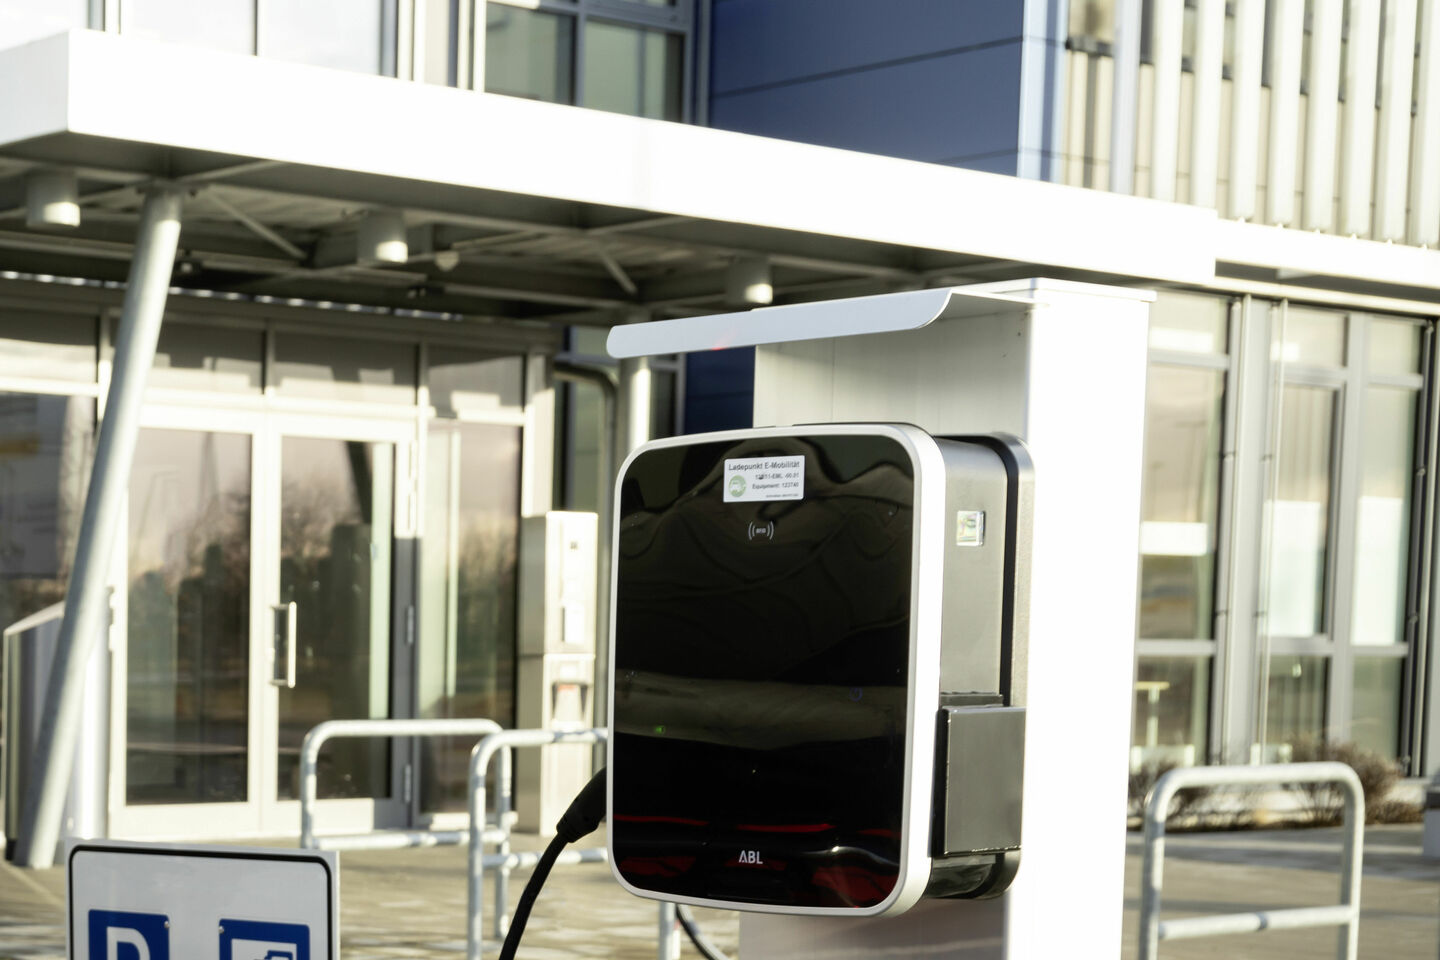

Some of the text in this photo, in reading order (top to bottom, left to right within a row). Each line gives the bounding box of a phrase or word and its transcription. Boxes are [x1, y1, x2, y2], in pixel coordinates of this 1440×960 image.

[728, 461, 800, 472] Ladepunkt E-Mobilität
[739, 850, 763, 865] ABL
